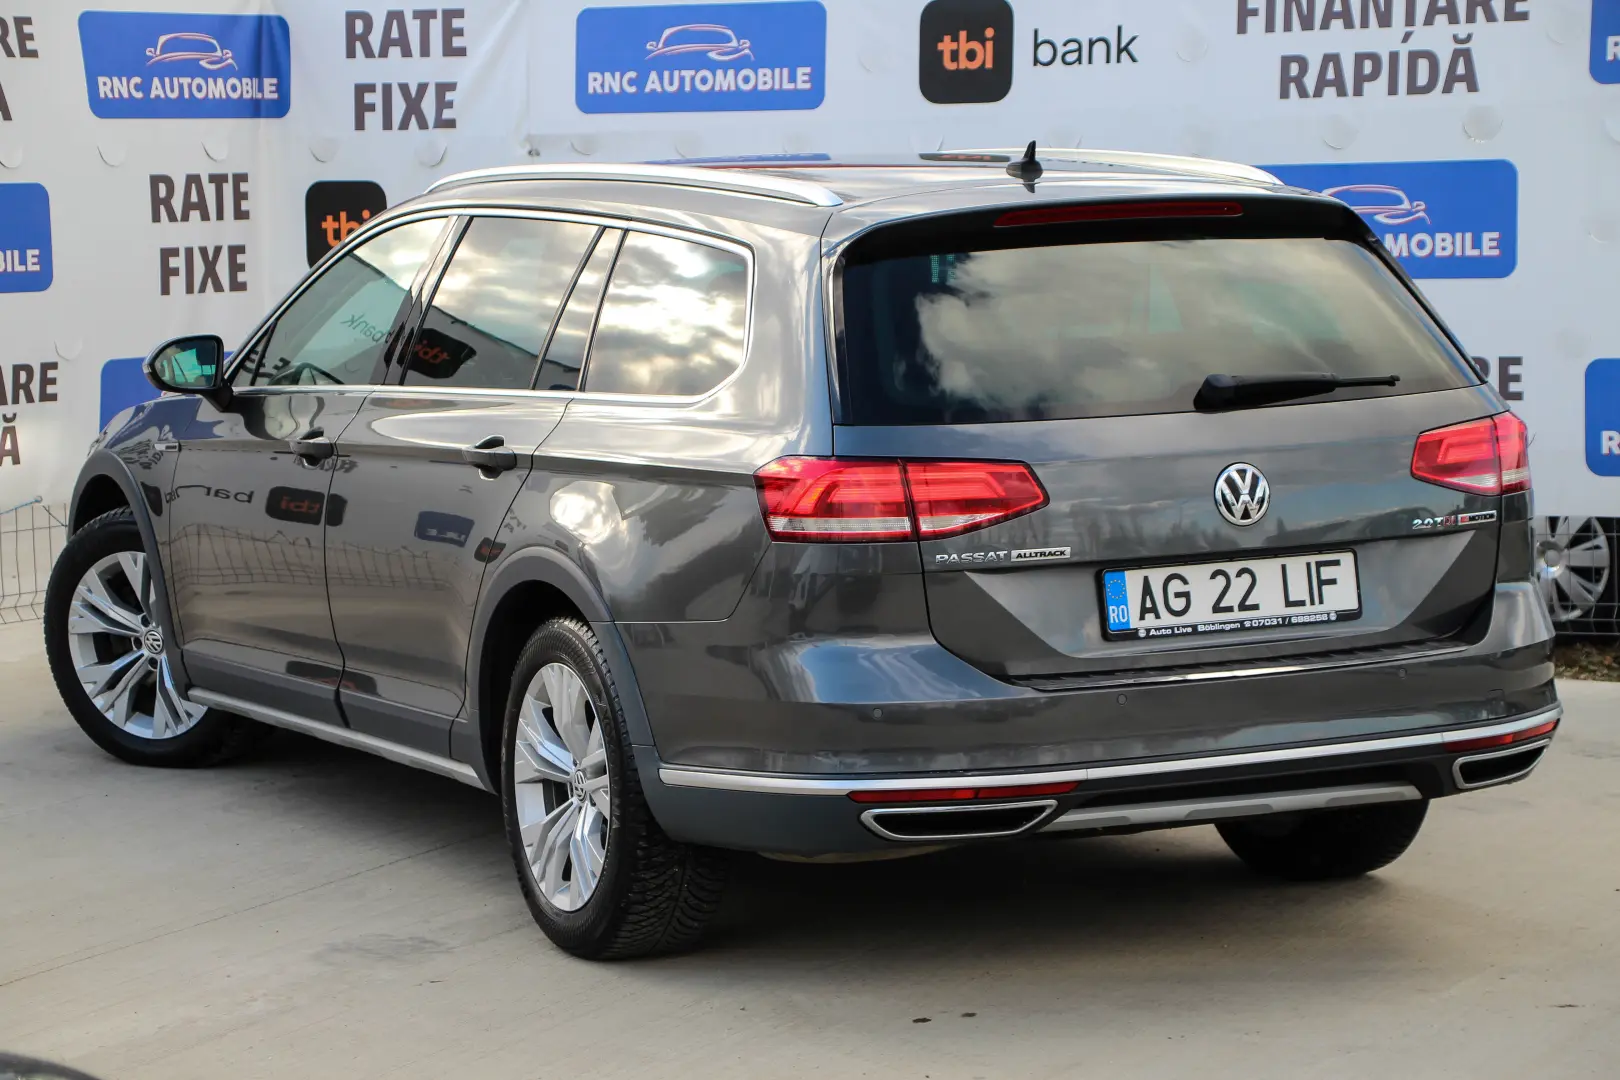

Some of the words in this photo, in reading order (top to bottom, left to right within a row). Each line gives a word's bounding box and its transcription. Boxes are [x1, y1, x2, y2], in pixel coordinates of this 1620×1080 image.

[345, 9, 468, 59] RATE
[937, 27, 994, 71] tbi
[1033, 25, 1139, 67] bank
[97, 76, 144, 100] RNC
[150, 76, 279, 100] AUTOMOBILE
[587, 71, 638, 95] RNC
[644, 66, 812, 93] AUTOMOBILE
[354, 81, 458, 131] FIXE
[149, 172, 250, 224] RATE
[160, 244, 248, 295] FIXE
[935, 551, 1008, 564] PASSAT
[1015, 549, 1067, 560] ALLTRACK
[1139, 573, 1191, 621] AG
[1209, 567, 1260, 614] 22
[1281, 559, 1341, 608] LIF
[1109, 605, 1129, 623] RO
[1149, 628, 1172, 636] Auto
[1174, 626, 1193, 634] Live
